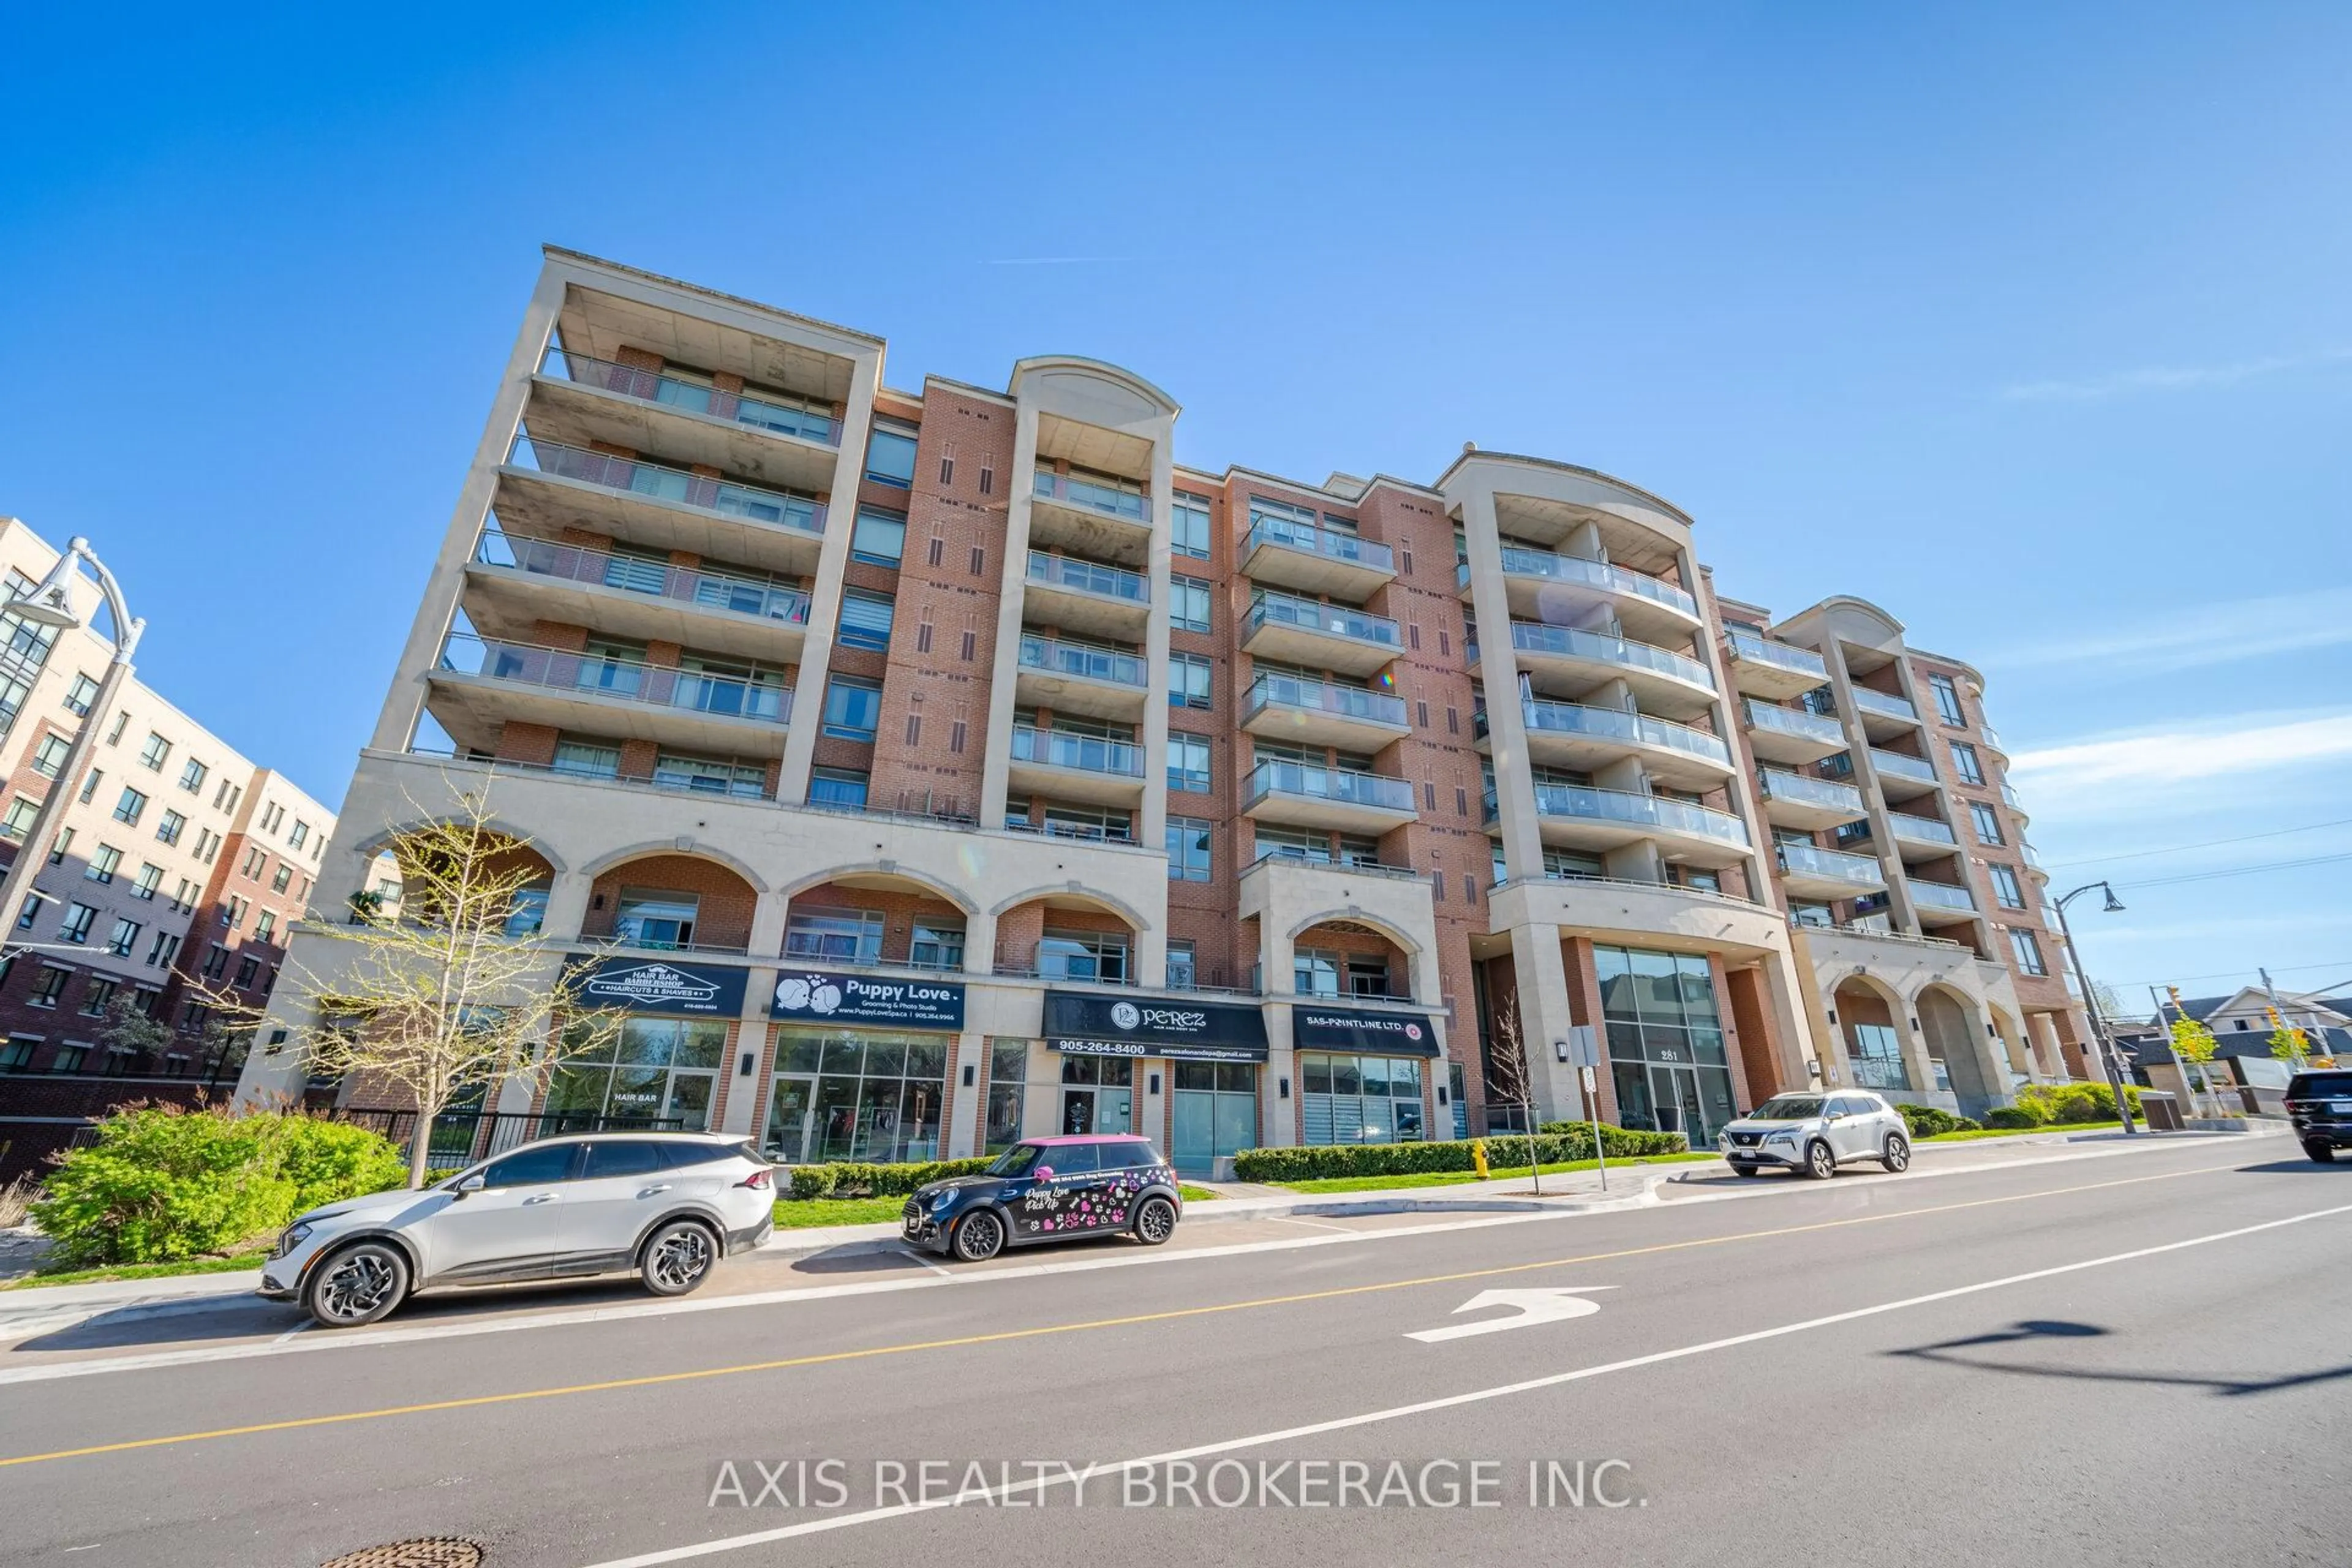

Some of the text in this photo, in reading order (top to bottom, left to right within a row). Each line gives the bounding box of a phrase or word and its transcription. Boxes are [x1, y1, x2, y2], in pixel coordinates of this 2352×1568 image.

[632, 971, 679, 982] HAIR BAR
[624, 978, 684, 988] BARBERSHOP
[610, 986, 652, 995] HAIRCUTS
[846, 980, 951, 1001] Puppy Love
[861, 1000, 892, 1009] Grooming
[1060, 1040, 1145, 1054] 905-264-8400
[638, 1094, 657, 1102] BAR
[1025, 1186, 1069, 1201] Puppy Love
[1025, 1197, 1059, 1212] Pick Up
